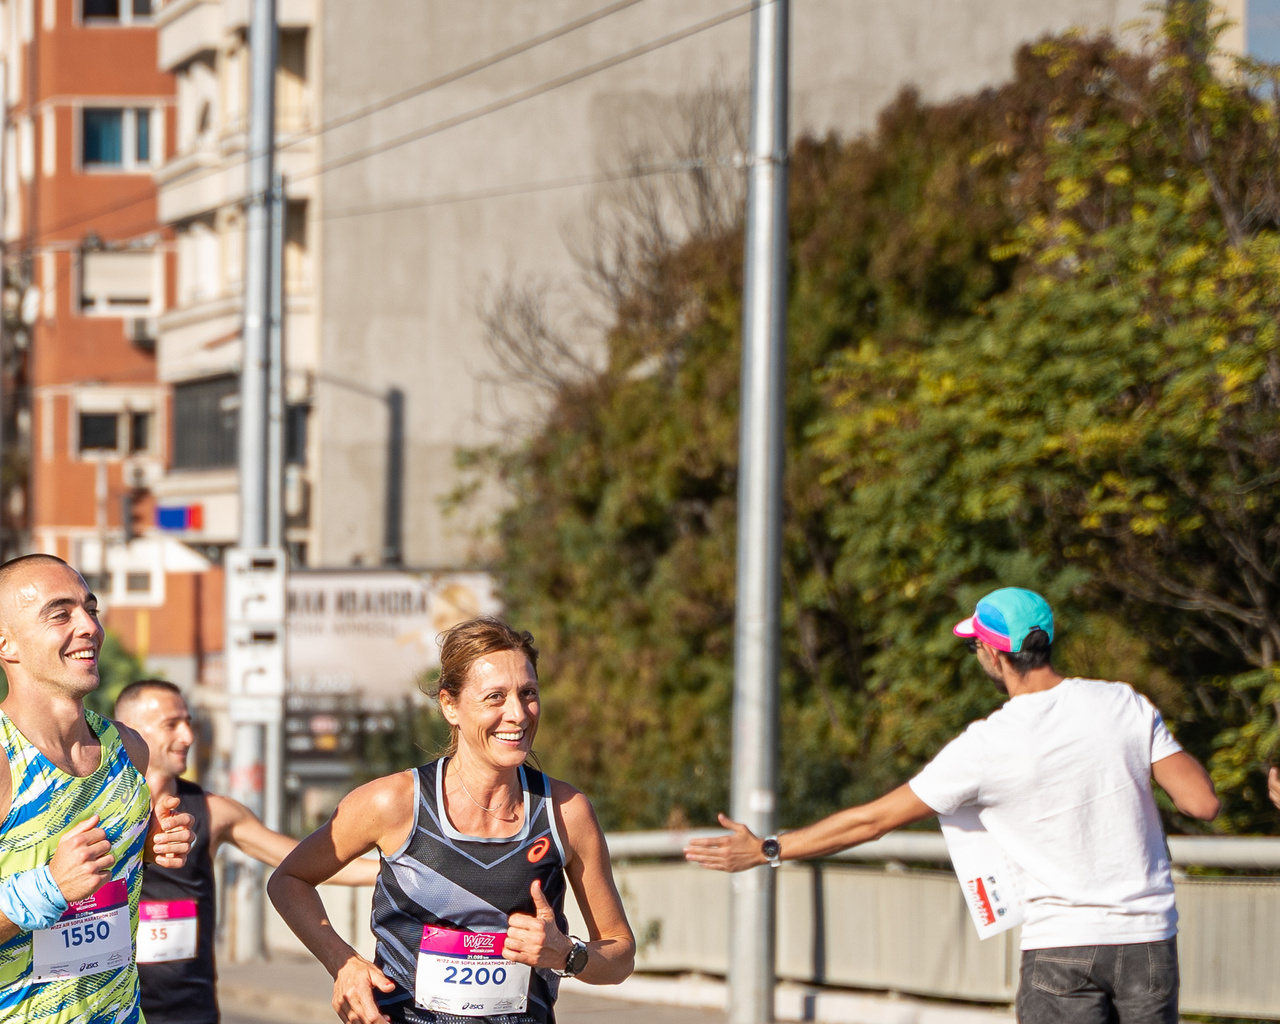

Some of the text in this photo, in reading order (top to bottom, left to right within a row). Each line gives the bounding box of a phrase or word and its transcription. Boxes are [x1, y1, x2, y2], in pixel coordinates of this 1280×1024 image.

[84, 914, 108, 922] MARATHON
[61, 920, 110, 948] 1550
[444, 966, 507, 985] 2200
